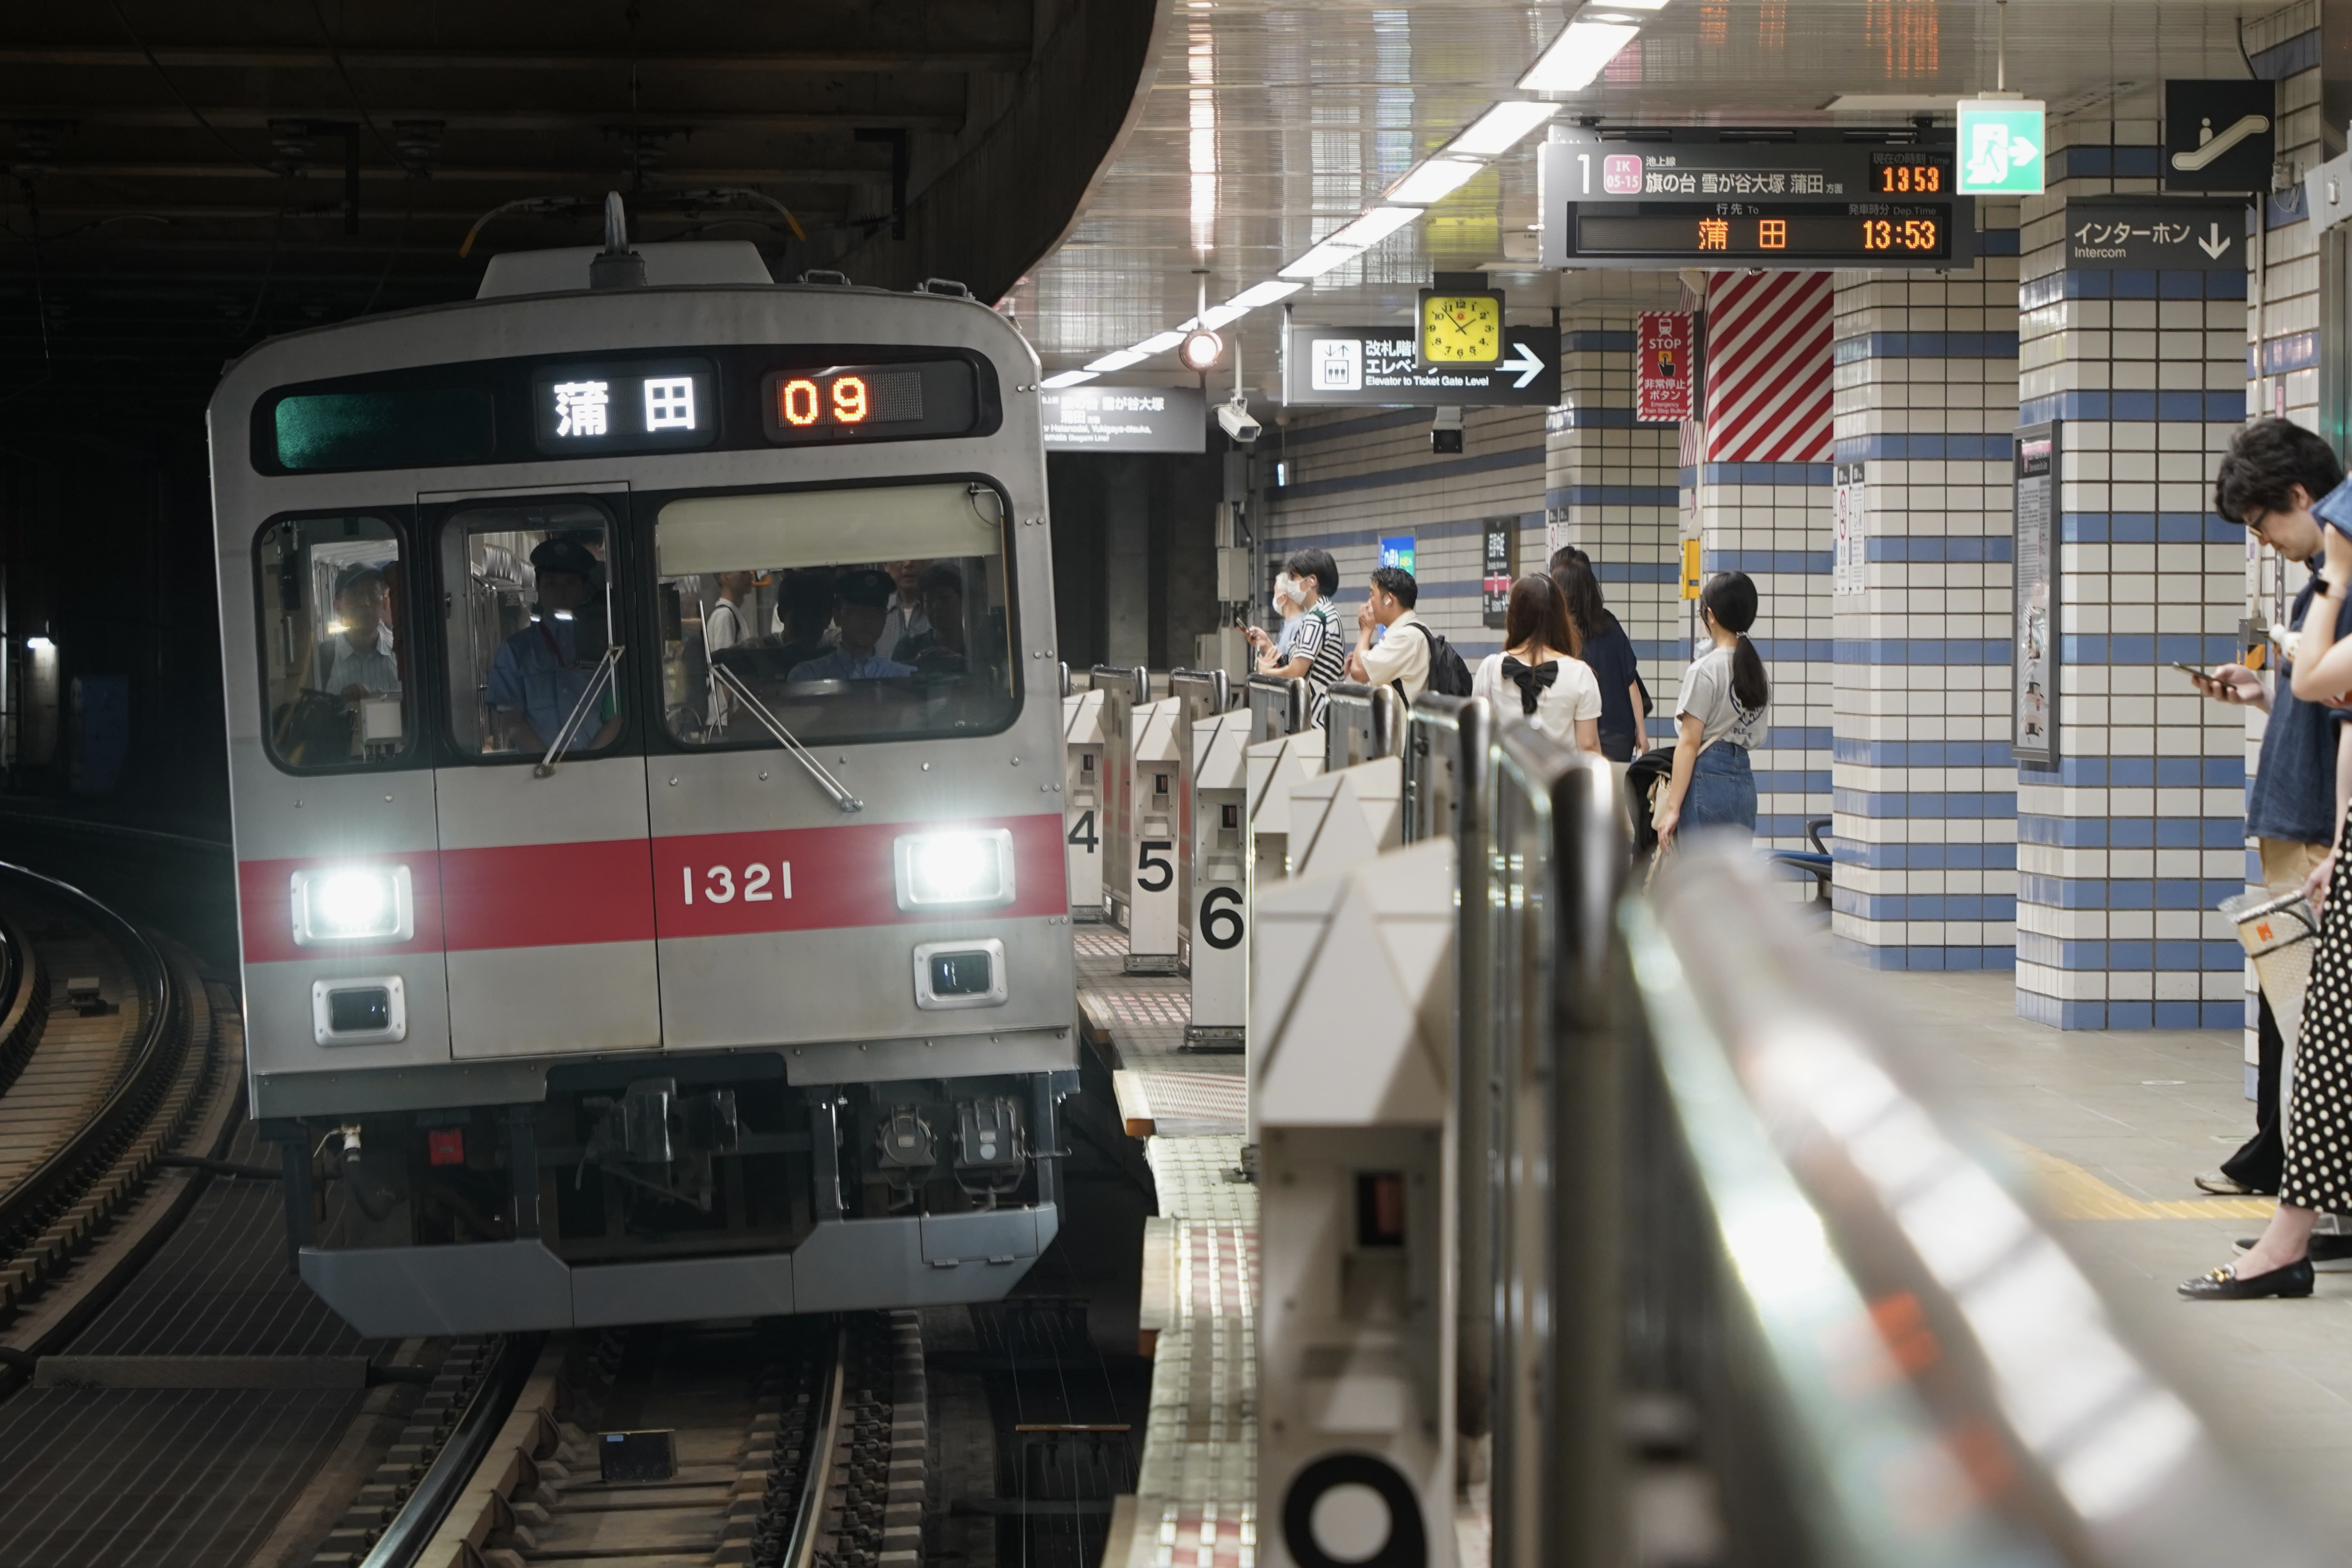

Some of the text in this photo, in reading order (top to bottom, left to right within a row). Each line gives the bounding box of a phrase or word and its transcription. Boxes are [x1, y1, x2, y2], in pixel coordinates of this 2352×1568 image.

[1646, 156, 1676, 167] 池上線
[1873, 153, 1950, 165] 現在の時刻 Time
[1616, 160, 1631, 172] IK
[1577, 154, 1590, 194] 1
[1606, 174, 1639, 189] 05-15
[1646, 173, 1843, 194] 旗の台 雪が谷大塚 蒲田 方面
[1716, 203, 1760, 215] 行先 To
[1848, 203, 1890, 216] 発車時分
[1699, 218, 1786, 249] 蒲田
[1864, 220, 1935, 249] 13:53
[2074, 222, 2190, 244] インターホン
[2074, 246, 2127, 258] Intercom
[1649, 338, 1682, 350] STOP
[1457, 349, 1463, 357] 6
[1366, 375, 1489, 386] Elevator to Ticket Gate Level
[1644, 378, 1686, 389] 非常停止
[784, 376, 867, 425] 09
[1650, 390, 1681, 400] ボタン
[554, 377, 696, 437] 蒲田
[1044, 433, 1067, 441] amata
[1733, 727, 1753, 740] PLEE
[1068, 810, 1099, 853] 4
[1137, 841, 1173, 892] 5
[683, 860, 792, 905] 1321
[1200, 887, 1244, 949] 6
